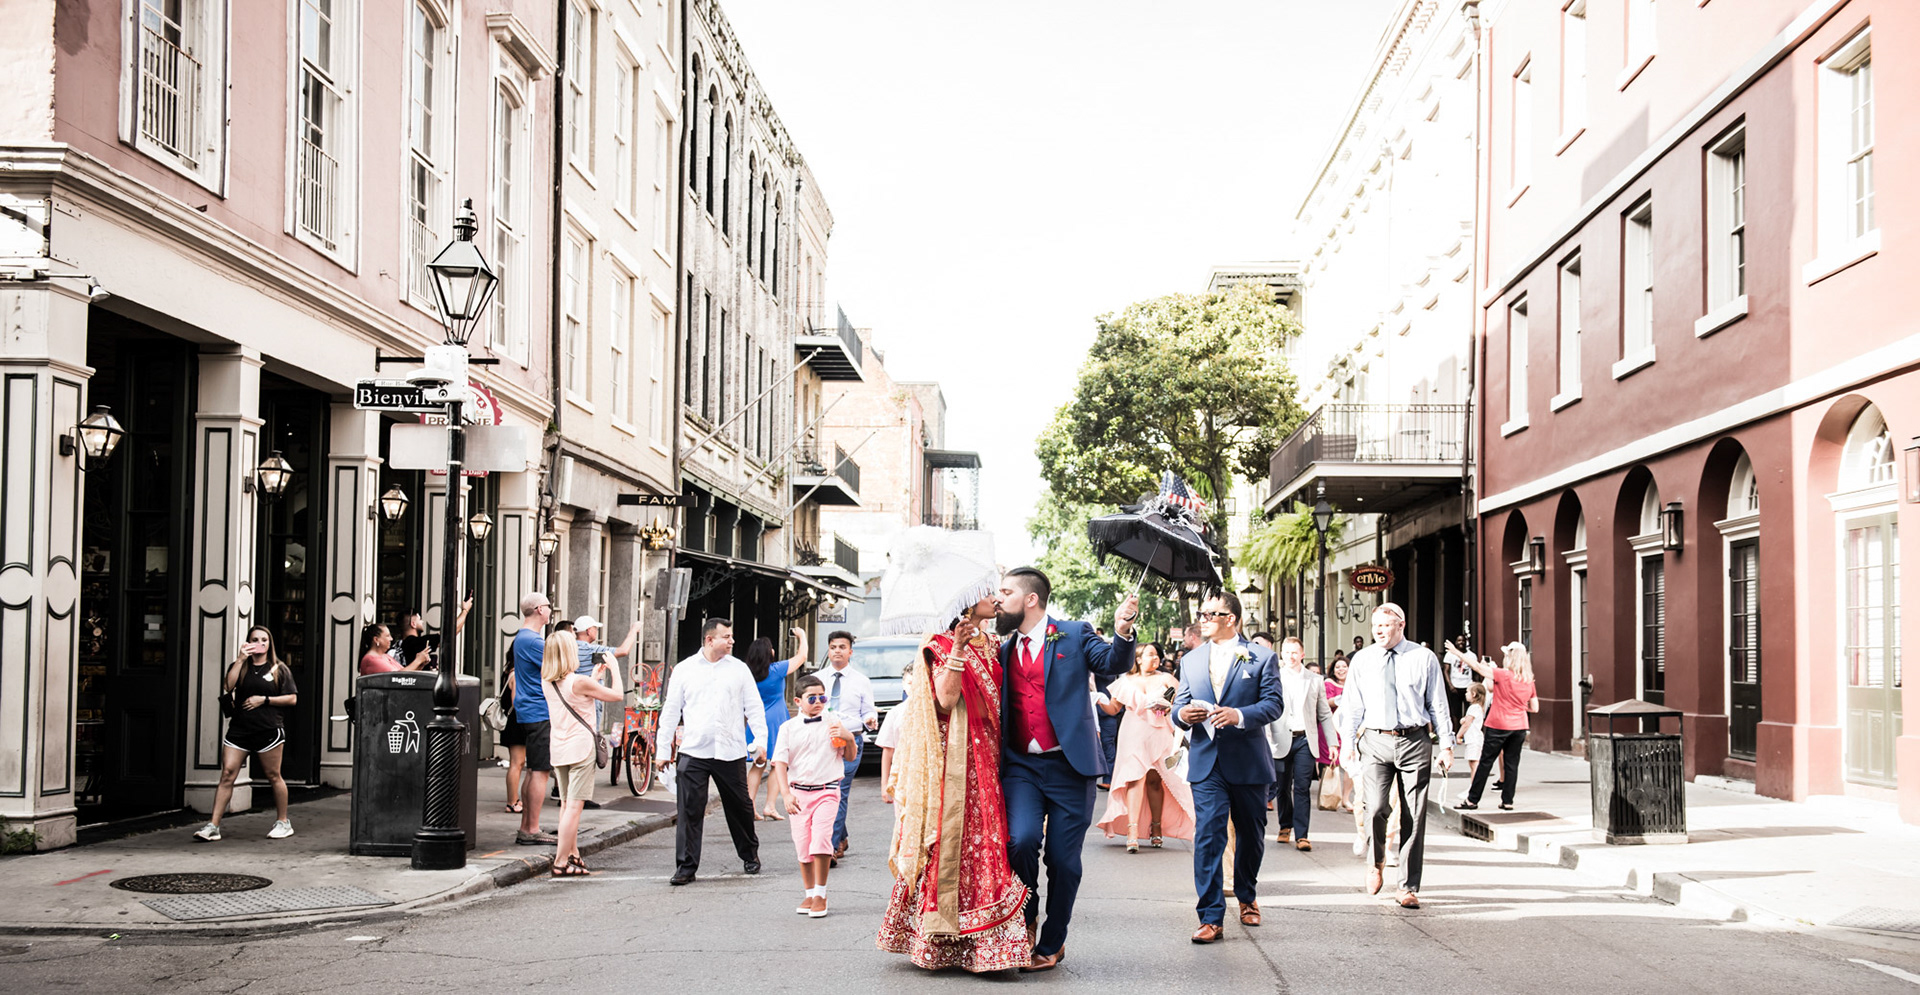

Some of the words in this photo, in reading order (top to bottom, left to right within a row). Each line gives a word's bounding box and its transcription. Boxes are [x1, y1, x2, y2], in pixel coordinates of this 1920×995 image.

[359, 388, 444, 405] Bienvil
[638, 495, 677, 504] FAM
[644, 527, 670, 536] NOLA
